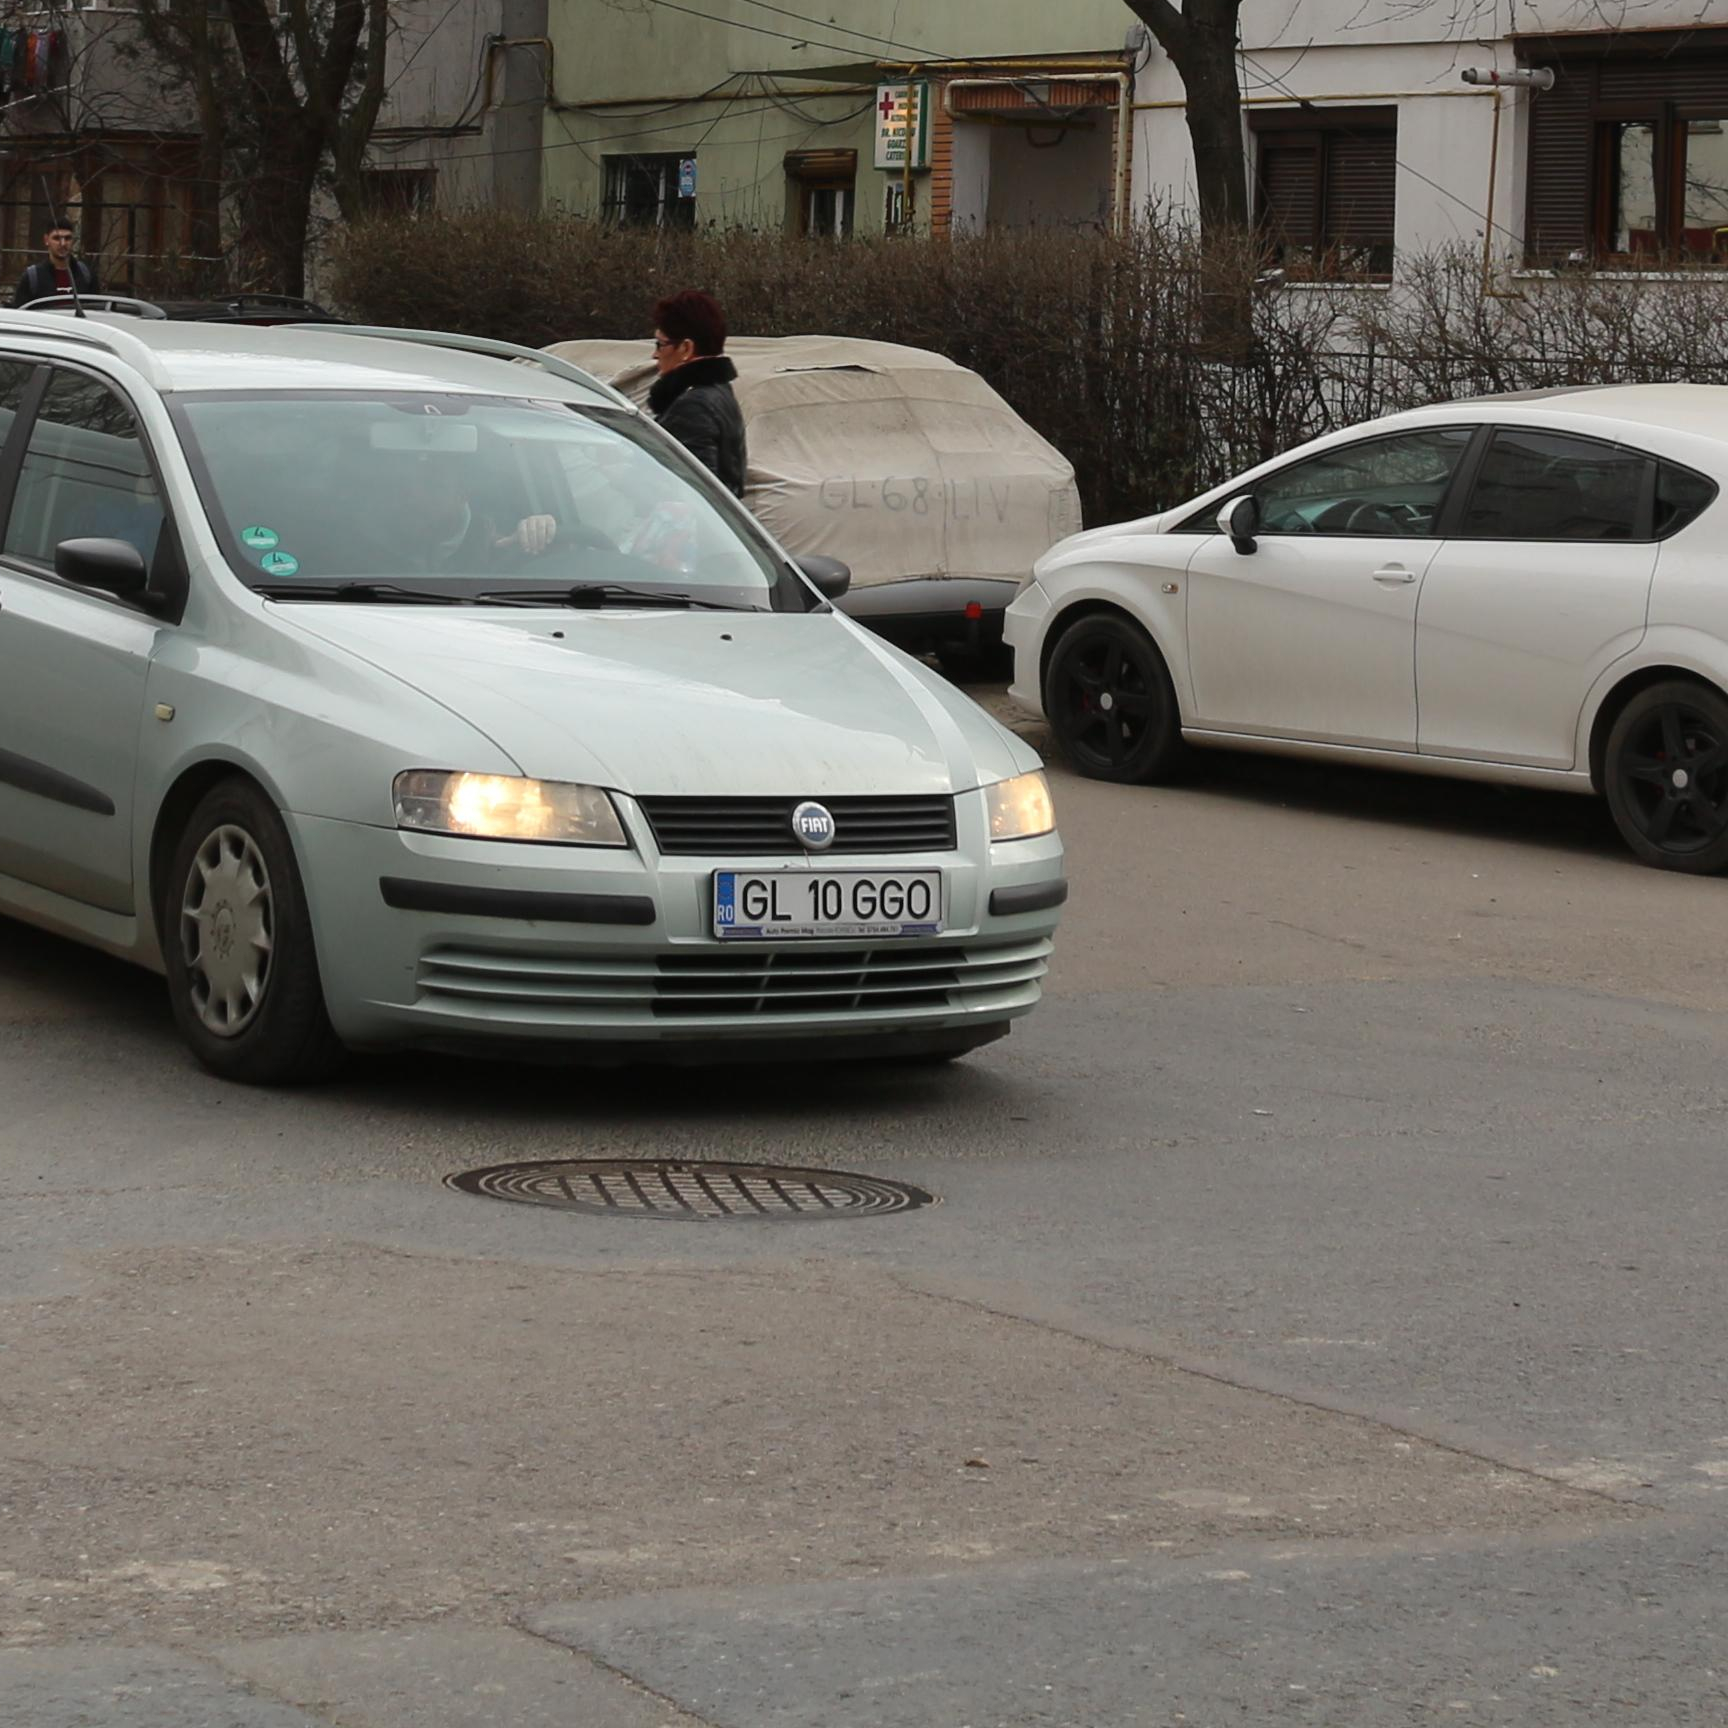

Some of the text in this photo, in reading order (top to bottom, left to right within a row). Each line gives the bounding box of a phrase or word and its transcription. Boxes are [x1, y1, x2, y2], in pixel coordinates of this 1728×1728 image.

[254, 527, 265, 538] 4
[272, 552, 284, 563] 4
[801, 816, 828, 833] FIAT
[741, 878, 932, 922] GL 10 GGO
[717, 905, 734, 922] RO
